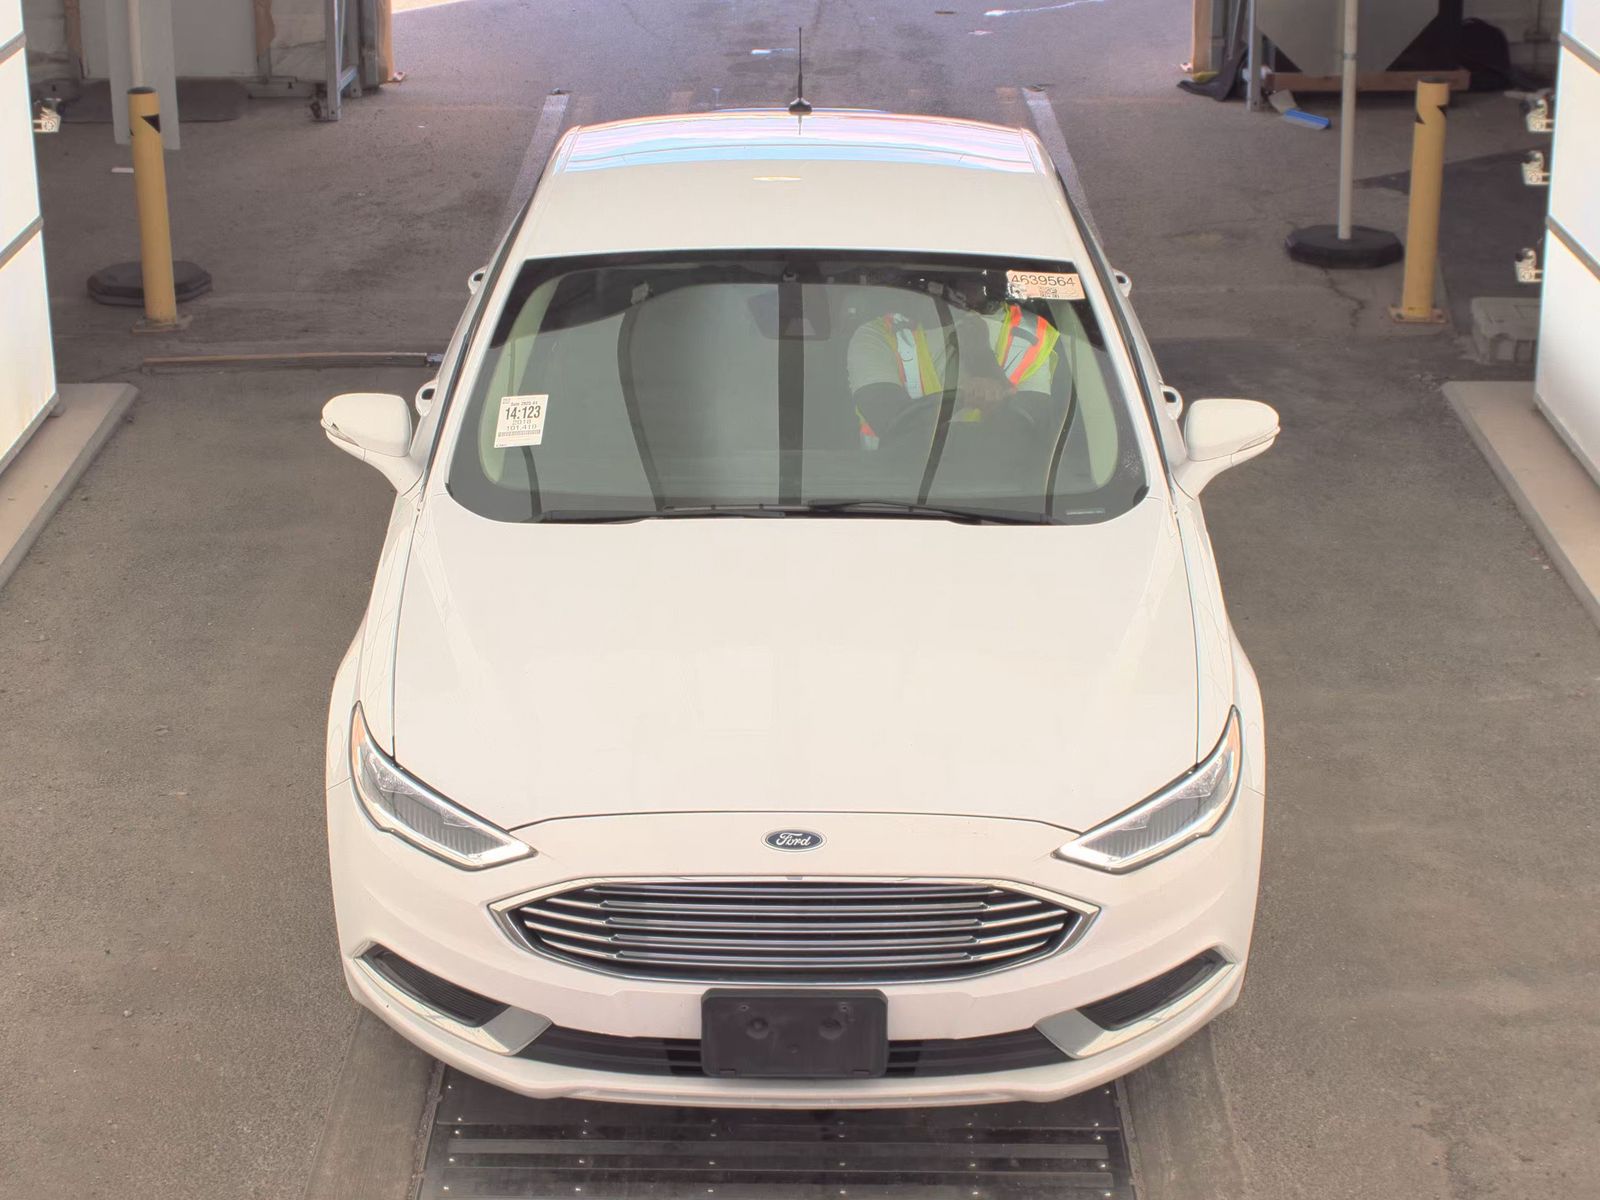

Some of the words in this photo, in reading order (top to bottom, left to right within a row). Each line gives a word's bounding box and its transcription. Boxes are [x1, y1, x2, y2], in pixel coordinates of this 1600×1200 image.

[1011, 274, 1076, 287] 4639564
[505, 405, 541, 420] 14:123
[775, 832, 812, 846] Ford
